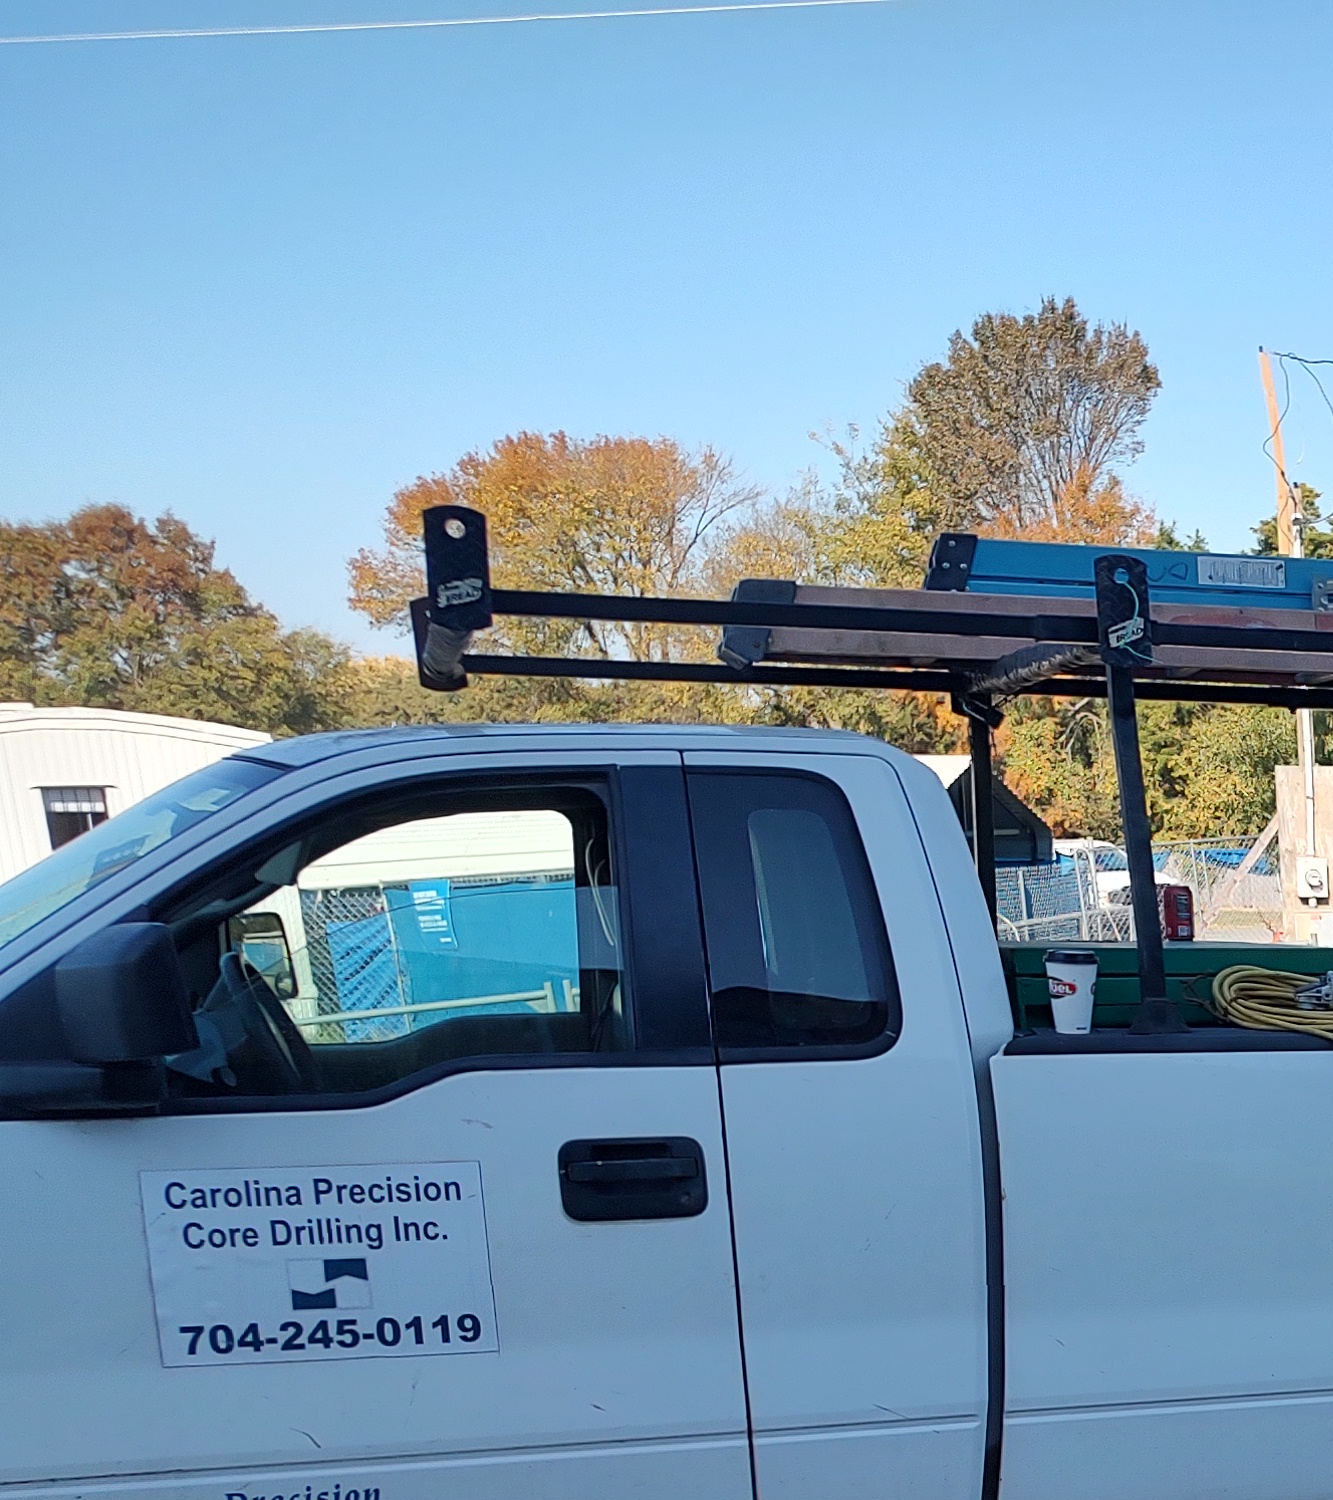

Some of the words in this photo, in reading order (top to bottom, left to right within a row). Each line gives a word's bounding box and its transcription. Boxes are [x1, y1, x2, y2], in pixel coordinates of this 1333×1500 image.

[164, 1179, 303, 1210] Carolina
[312, 1175, 462, 1205] Precision
[182, 1221, 260, 1249] Core
[269, 1218, 383, 1250] Drilling
[393, 1215, 449, 1242] Inc.
[179, 1313, 482, 1356] 704-245-0119
